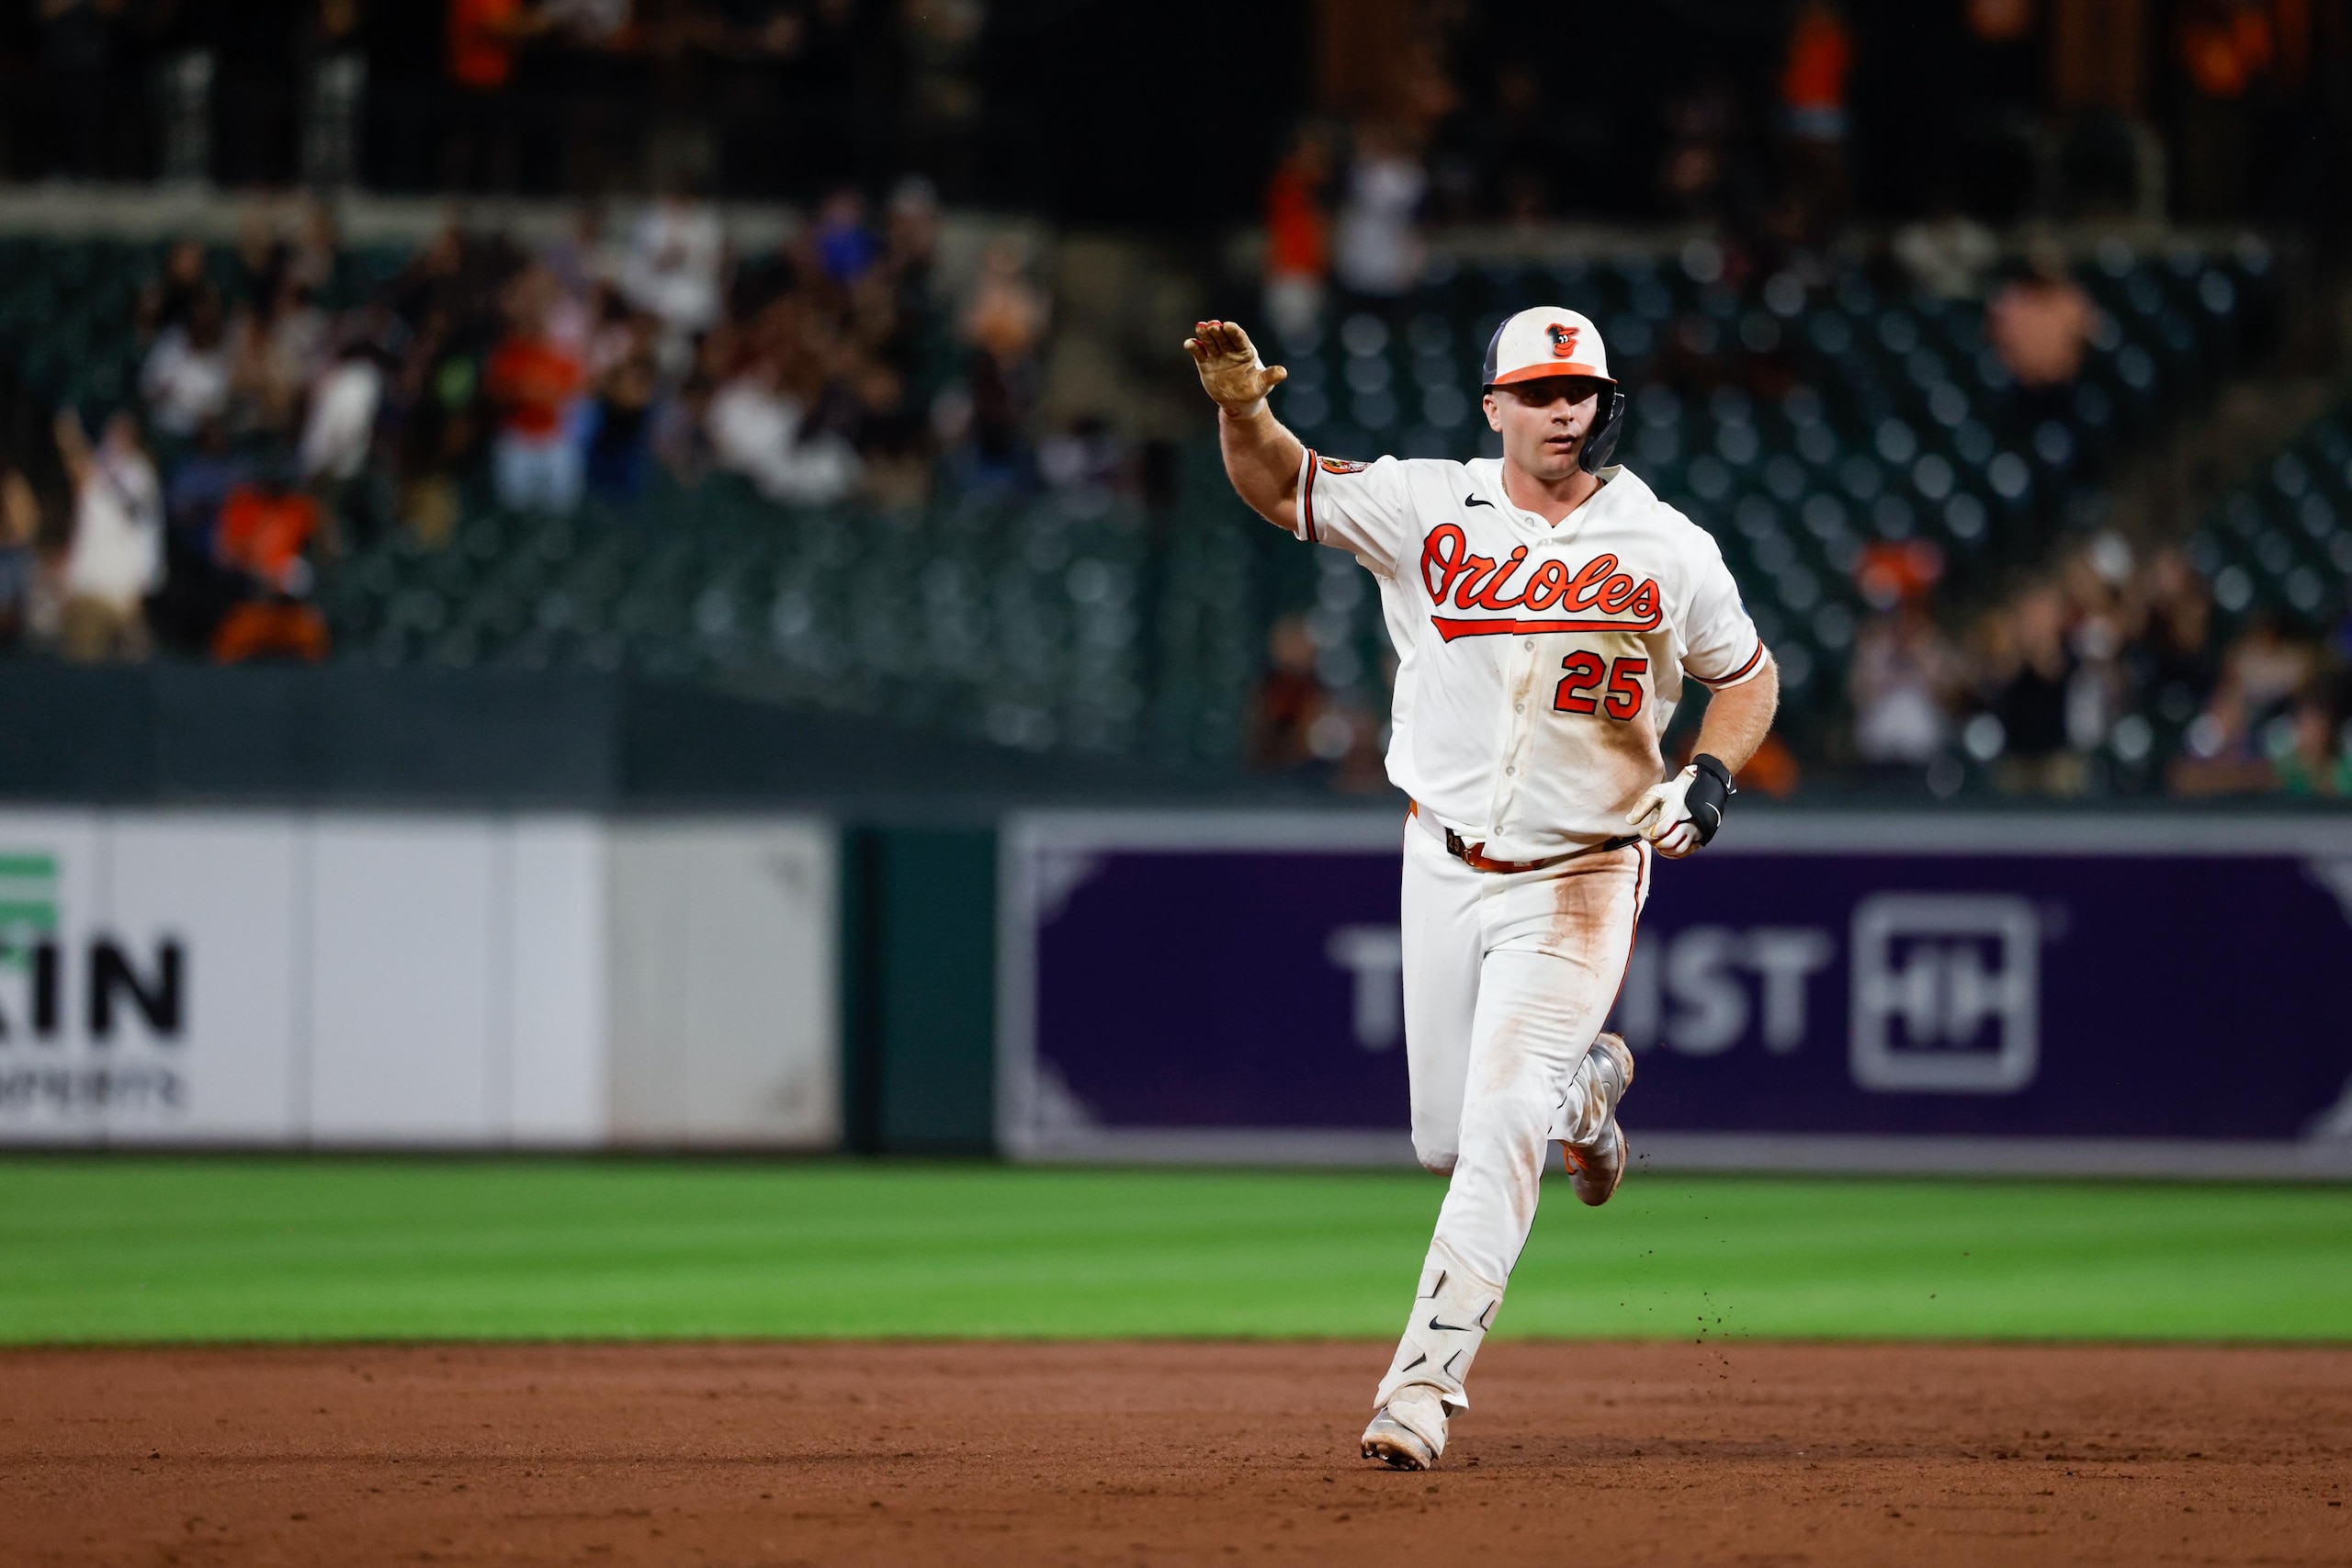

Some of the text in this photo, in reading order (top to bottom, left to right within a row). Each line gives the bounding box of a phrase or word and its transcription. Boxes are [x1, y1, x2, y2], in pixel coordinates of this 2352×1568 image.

[1420, 523, 1662, 619] Orioles
[1553, 649, 1649, 722] 25
[1447, 834, 1461, 853] 25
[1325, 925, 1832, 1054] TIST
